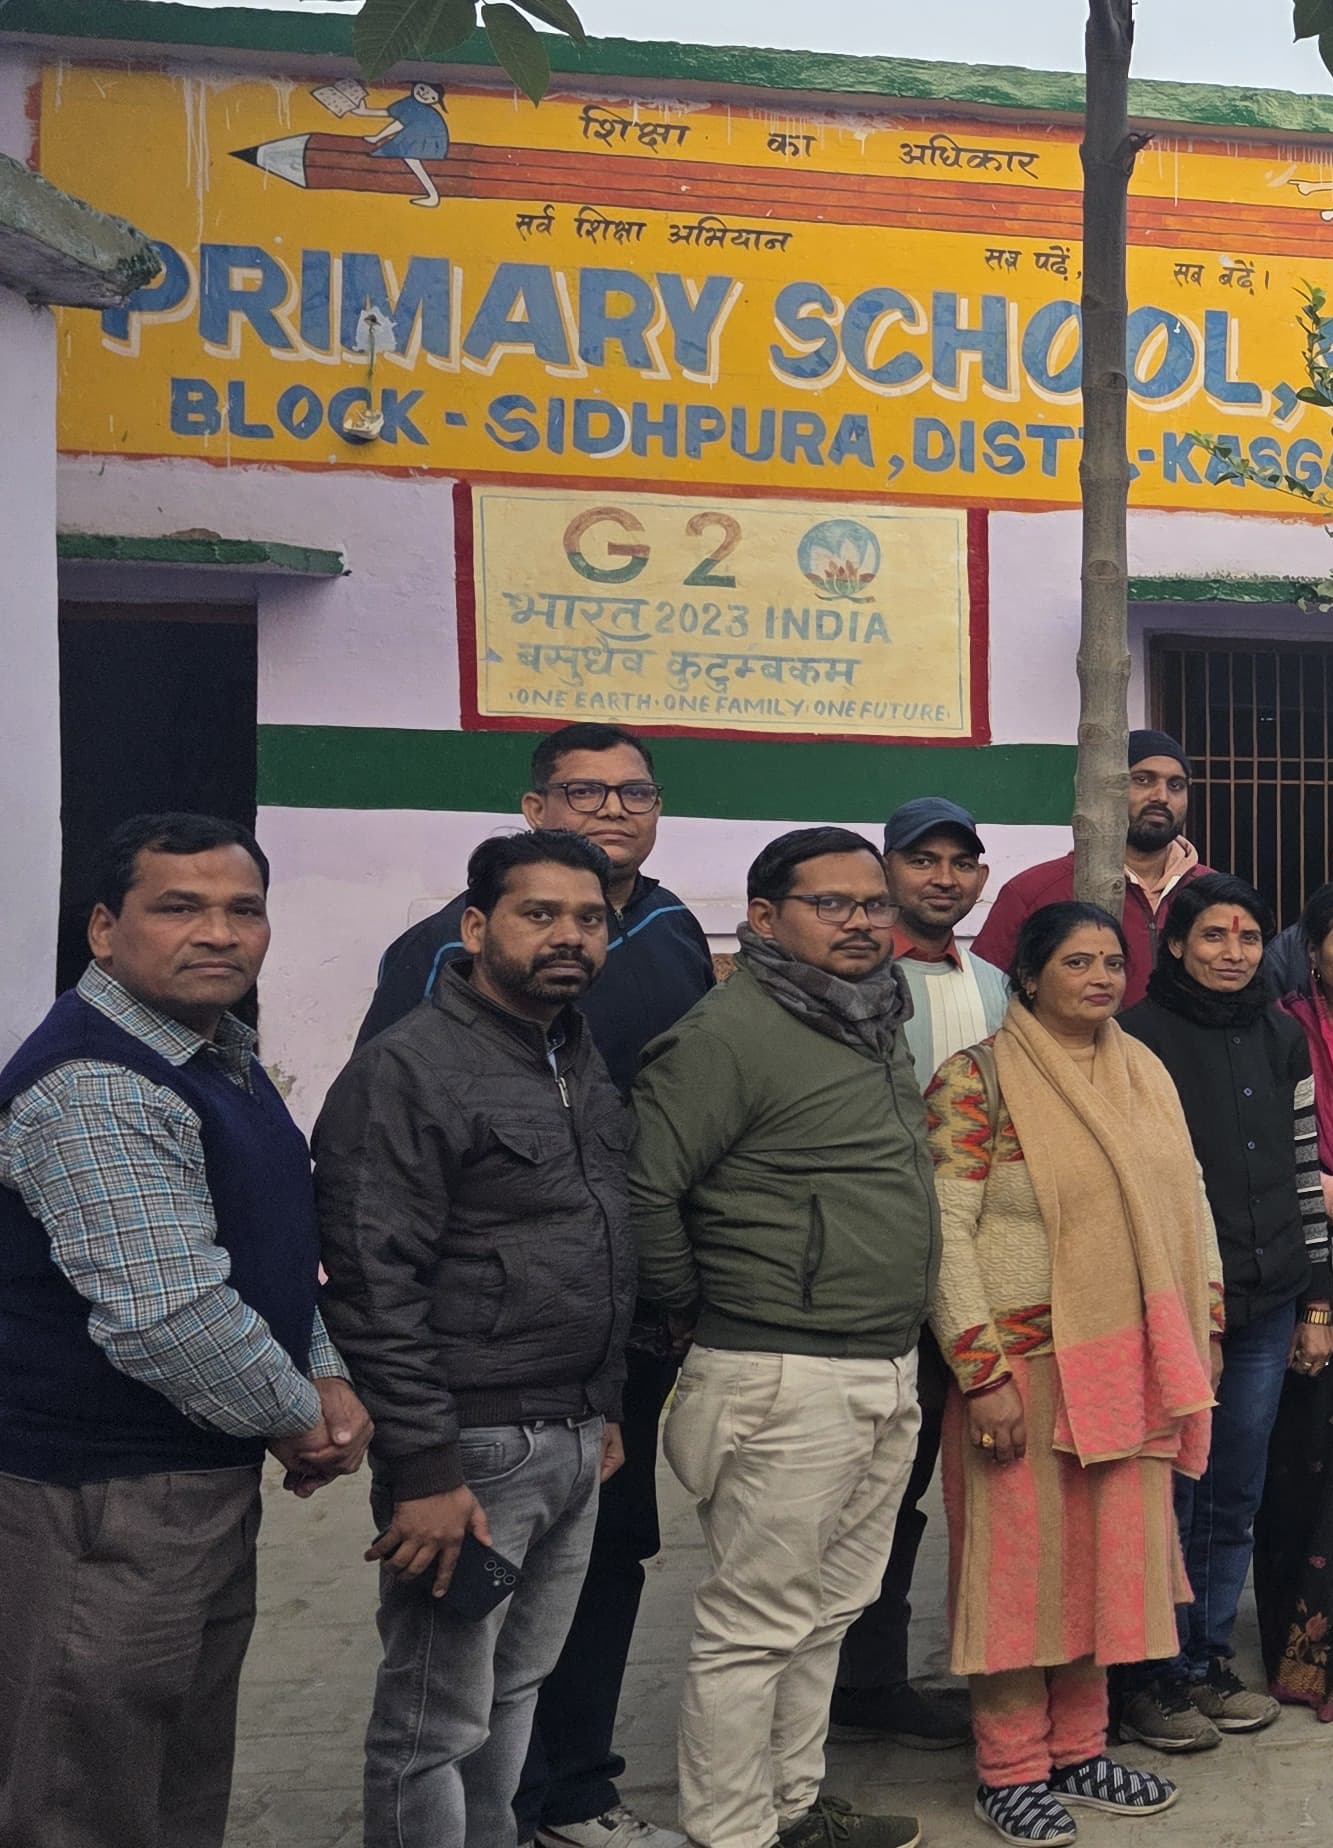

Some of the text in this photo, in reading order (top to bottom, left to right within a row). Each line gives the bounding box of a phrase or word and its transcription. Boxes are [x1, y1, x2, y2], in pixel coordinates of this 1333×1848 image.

[579, 104, 1040, 180] शिक्षा का अधिकार
[516, 205, 793, 252] सर्व शिक्षा अभियान
[1174, 262, 1205, 287] सब
[102, 240, 741, 385] PRIMARY
[170, 377, 428, 445] BLOCK
[503, 592, 892, 644] भारत 2023 INDIA
[517, 689, 946, 722] ONE EARTH ONE FAMILY ONE FUTURE
